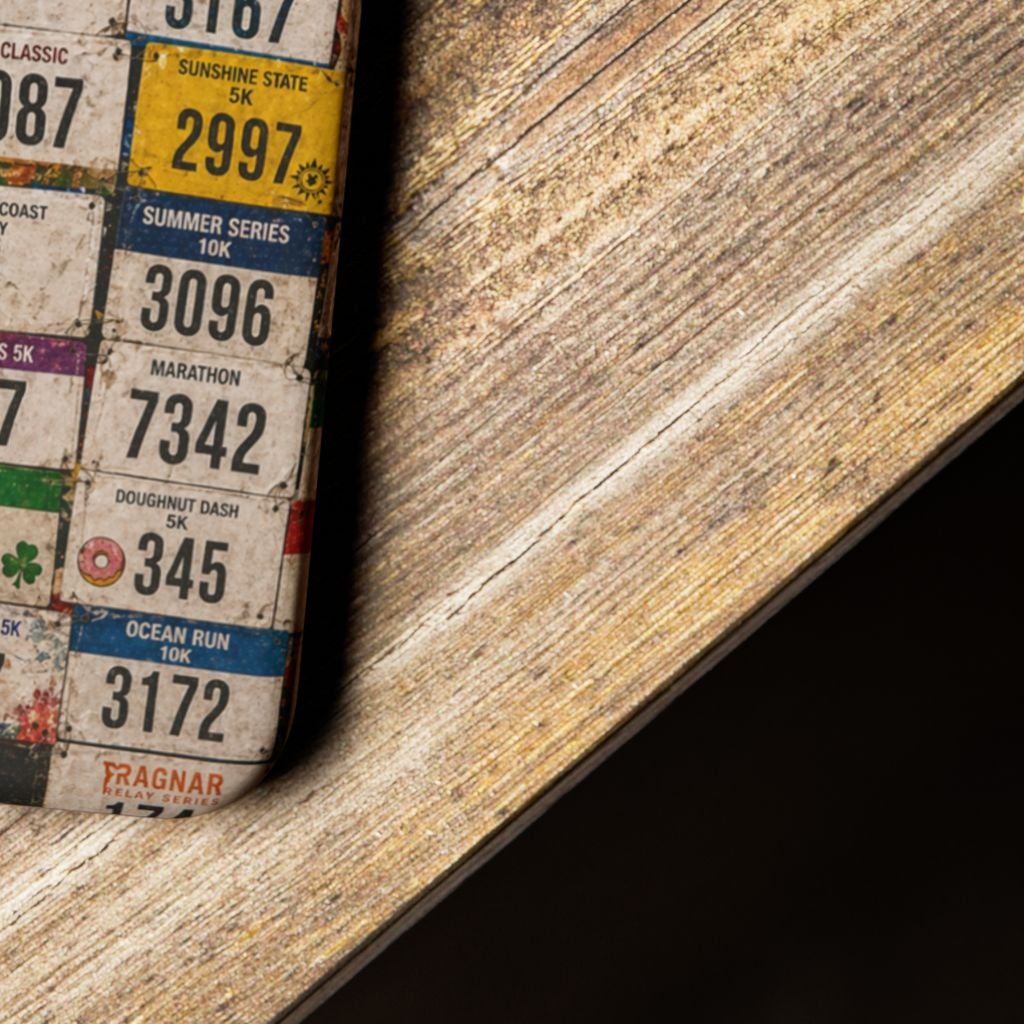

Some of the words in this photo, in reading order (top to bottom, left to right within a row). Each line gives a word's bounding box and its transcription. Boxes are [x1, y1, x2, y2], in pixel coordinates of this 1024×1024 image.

[0, 41, 69, 65] CLASSIC
[178, 58, 258, 85] SUNSHINE
[262, 71, 308, 92] STATE
[228, 86, 254, 106] 5K
[171, 108, 303, 185] 2997
[142, 205, 223, 235] SUMMER
[227, 216, 291, 245] SERIES
[198, 238, 232, 259] 10K
[140, 264, 275, 347] 3096
[12, 344, 36, 364] 5K
[149, 358, 242, 387] MARATHON
[126, 388, 267, 475] 7342
[115, 488, 197, 513] DOUGHNUT
[199, 500, 240, 519] DASH
[165, 513, 189, 531] 5K
[133, 532, 230, 604] 345
[0, 619, 23, 637] 5K
[125, 619, 188, 645] OCEAN
[191, 629, 231, 651] RUN
[160, 645, 193, 665] 10K
[101, 665, 231, 743] 3172
[102, 760, 225, 796] RAGNAR
[103, 787, 155, 802] RELAY
[162, 794, 221, 807] SERIES
